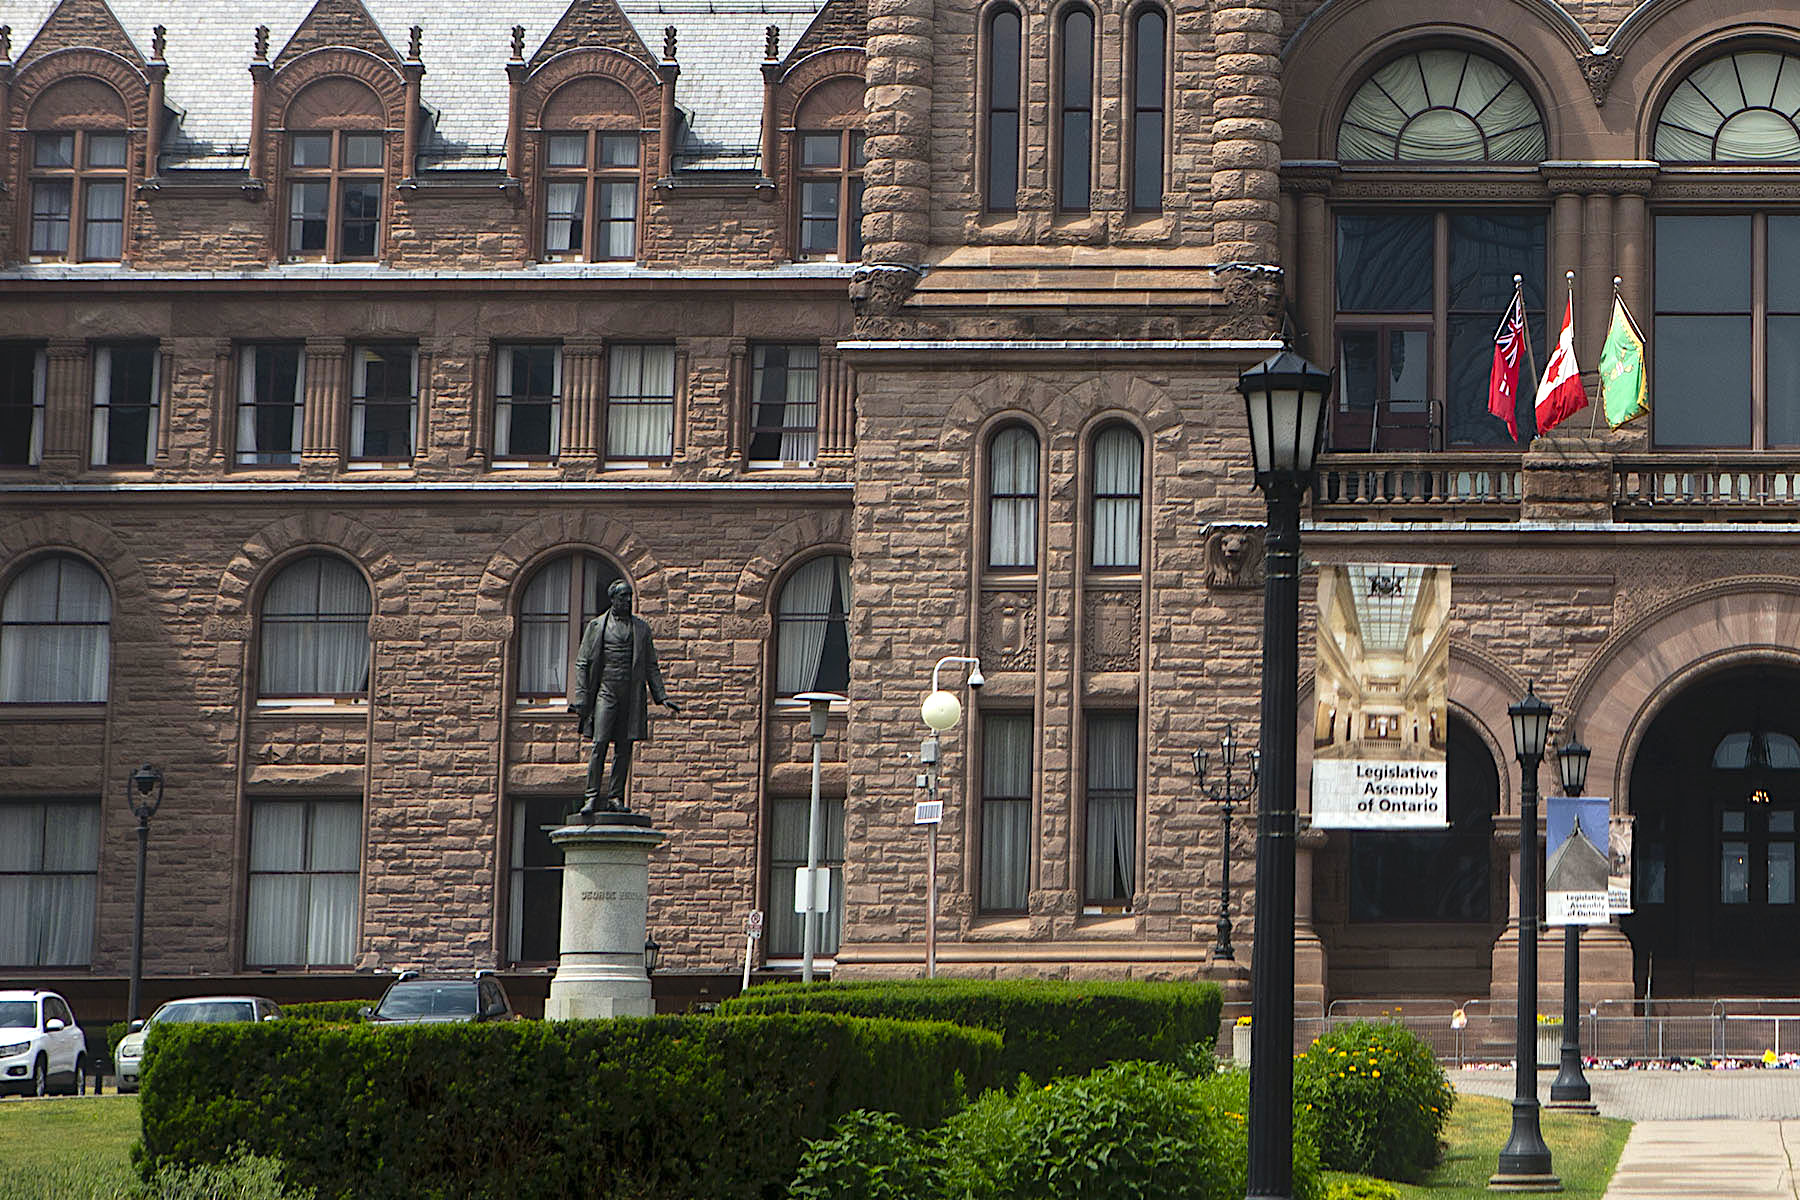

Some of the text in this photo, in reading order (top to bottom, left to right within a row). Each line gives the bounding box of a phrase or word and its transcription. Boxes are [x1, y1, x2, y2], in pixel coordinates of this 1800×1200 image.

[1356, 764, 1438, 781] Legislative
[1364, 782, 1438, 799] Assembly
[1357, 798, 1438, 812] of Ontario
